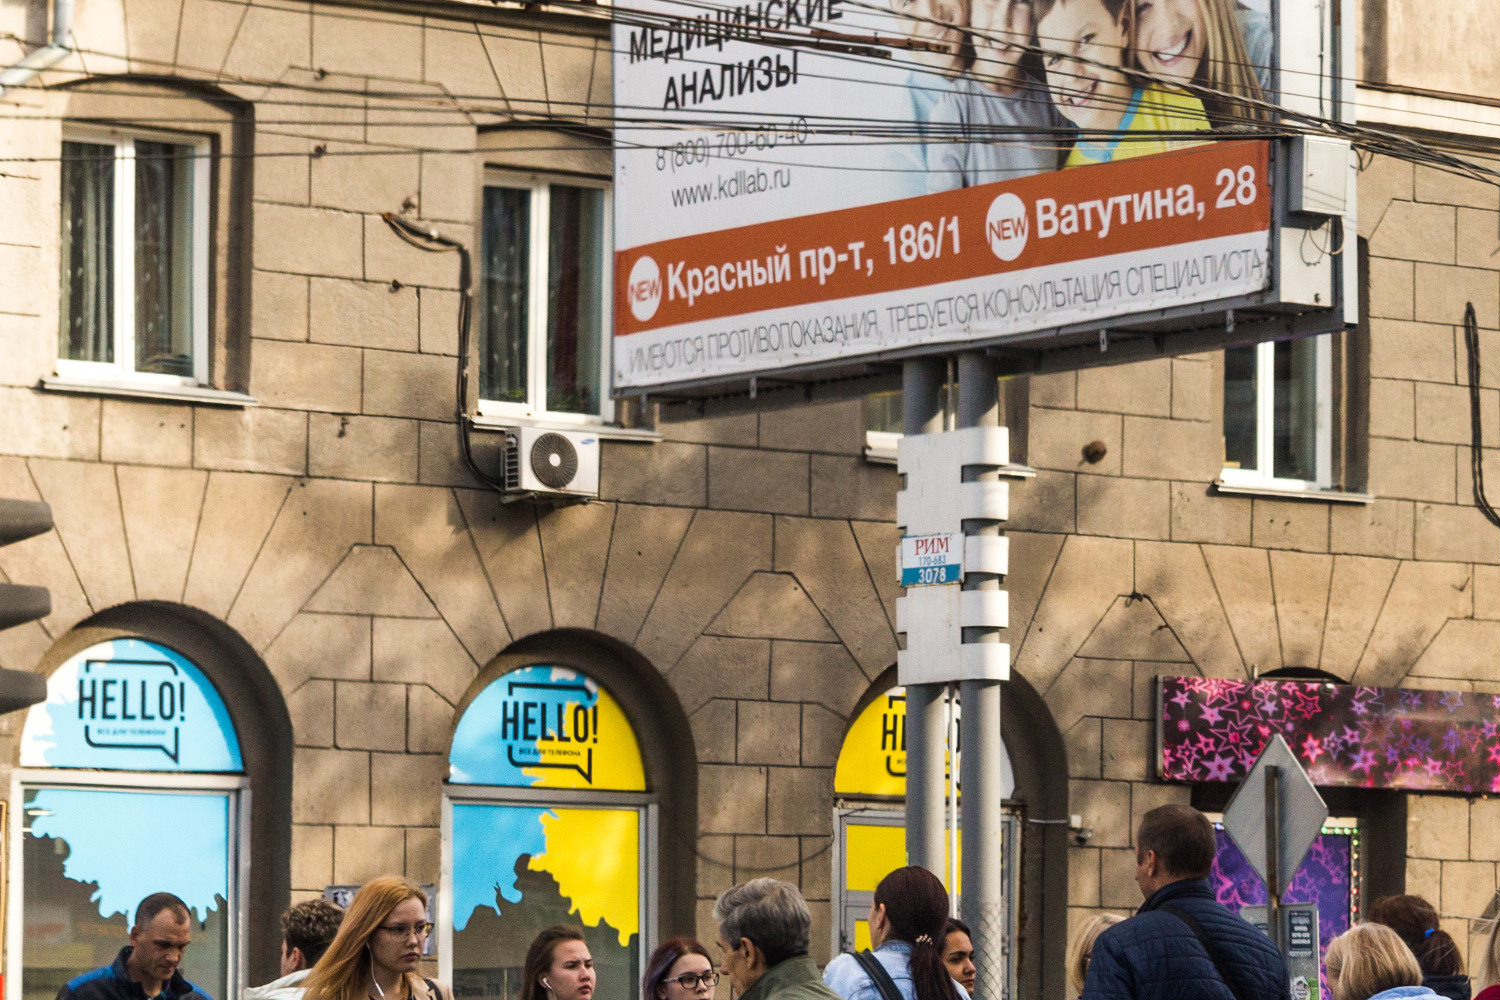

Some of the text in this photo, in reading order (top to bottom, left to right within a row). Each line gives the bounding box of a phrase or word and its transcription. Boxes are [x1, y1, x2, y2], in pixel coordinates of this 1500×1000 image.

[629, 0, 844, 64] МЕДИЦИНСКИЕ
[662, 50, 799, 111] АНАЛИЗЫ
[655, 147, 666, 171] 8
[670, 136, 711, 174] (800)
[671, 167, 792, 208] www.kdllab.ru
[1035, 164, 1258, 240] Ватутина, 28
[989, 216, 1028, 242] NEW
[667, 215, 961, 307] Красный пр-т, 186/1
[629, 278, 662, 302] NEW
[630, 249, 1263, 373] ИМЕЮТСЯ ПРОТИВОПОКАЗАНИЯ, ТРЕБУЕТСЯ КОНСУЛЬТАЦИЯ СПЕЦИАЛИСТА
[915, 537, 950, 556] РИМ
[918, 566, 947, 584] 3078
[78, 679, 185, 722] HELLO!
[501, 700, 598, 744] HELLO!
